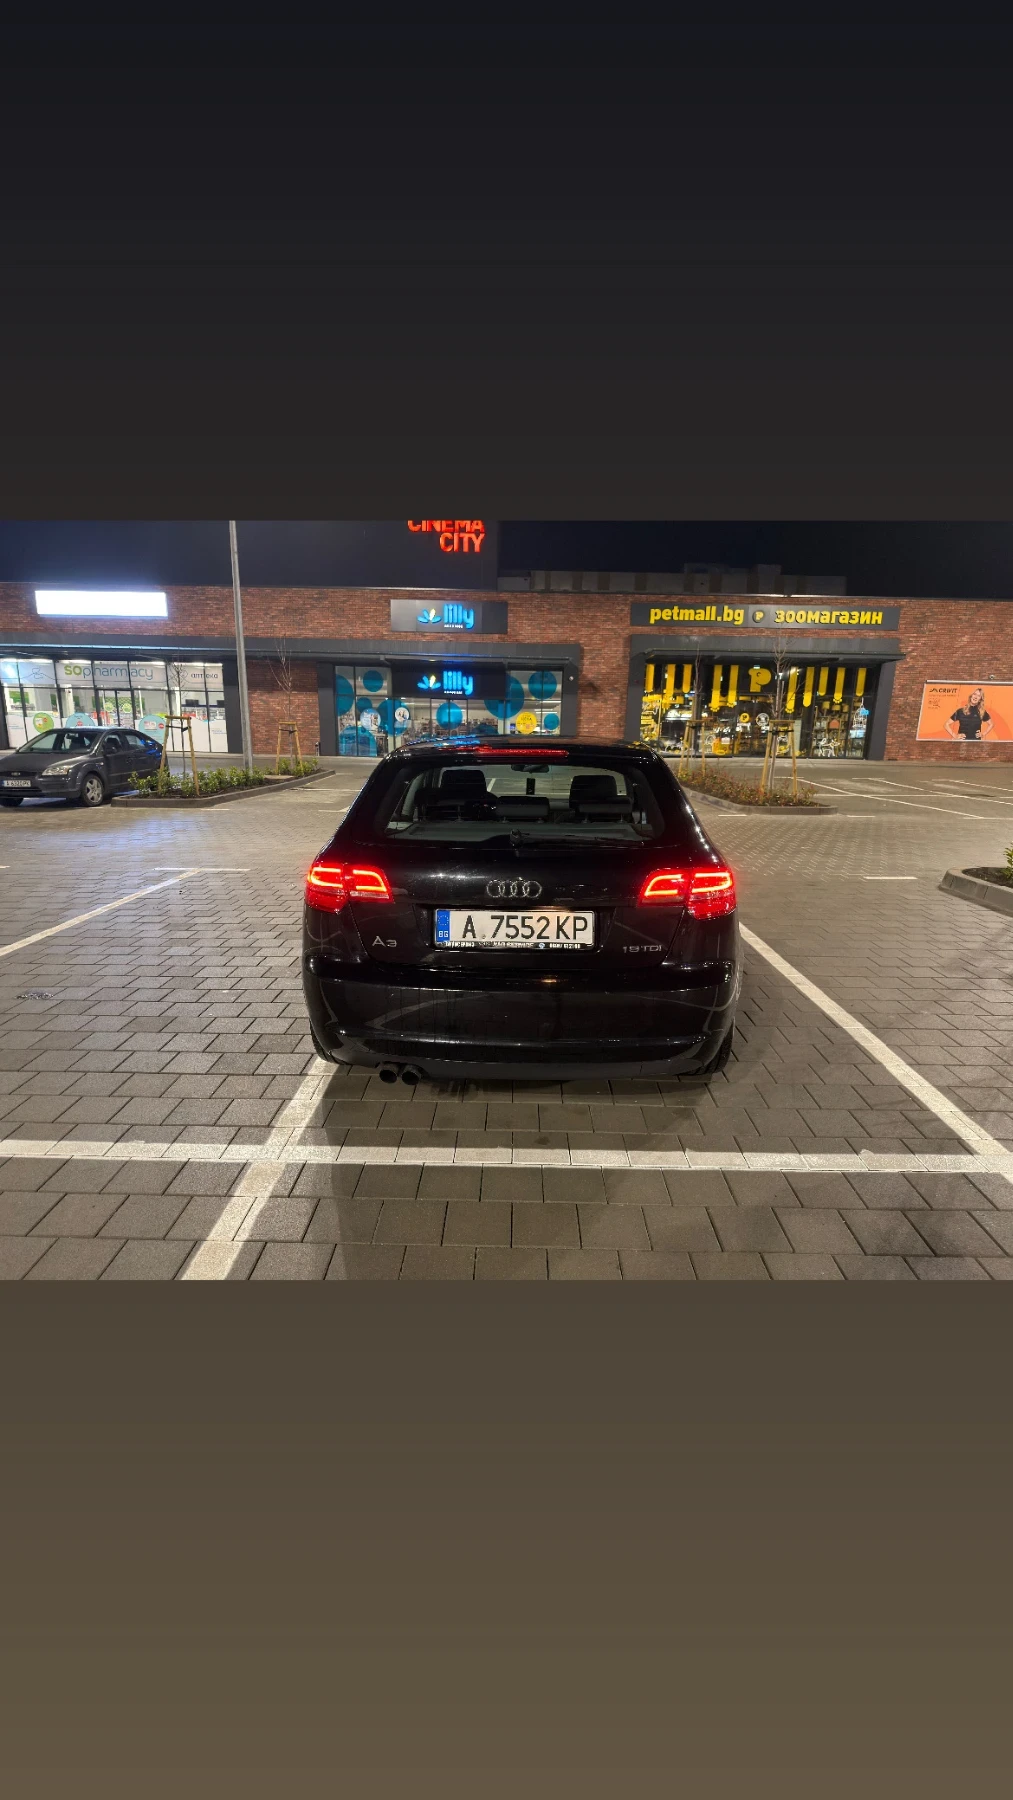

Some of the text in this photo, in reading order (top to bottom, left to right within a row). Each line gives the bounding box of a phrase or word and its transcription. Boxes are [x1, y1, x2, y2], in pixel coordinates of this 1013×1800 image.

[407, 520, 485, 532] CINEMA
[440, 532, 485, 552] CITY
[443, 603, 475, 629] lilly
[649, 605, 745, 625] petmall.bg
[774, 609, 883, 624] зоомагазин
[443, 670, 474, 695] lilly
[438, 930, 449, 938] BG
[462, 915, 588, 940] A 7552 KP
[372, 935, 397, 948] A3
